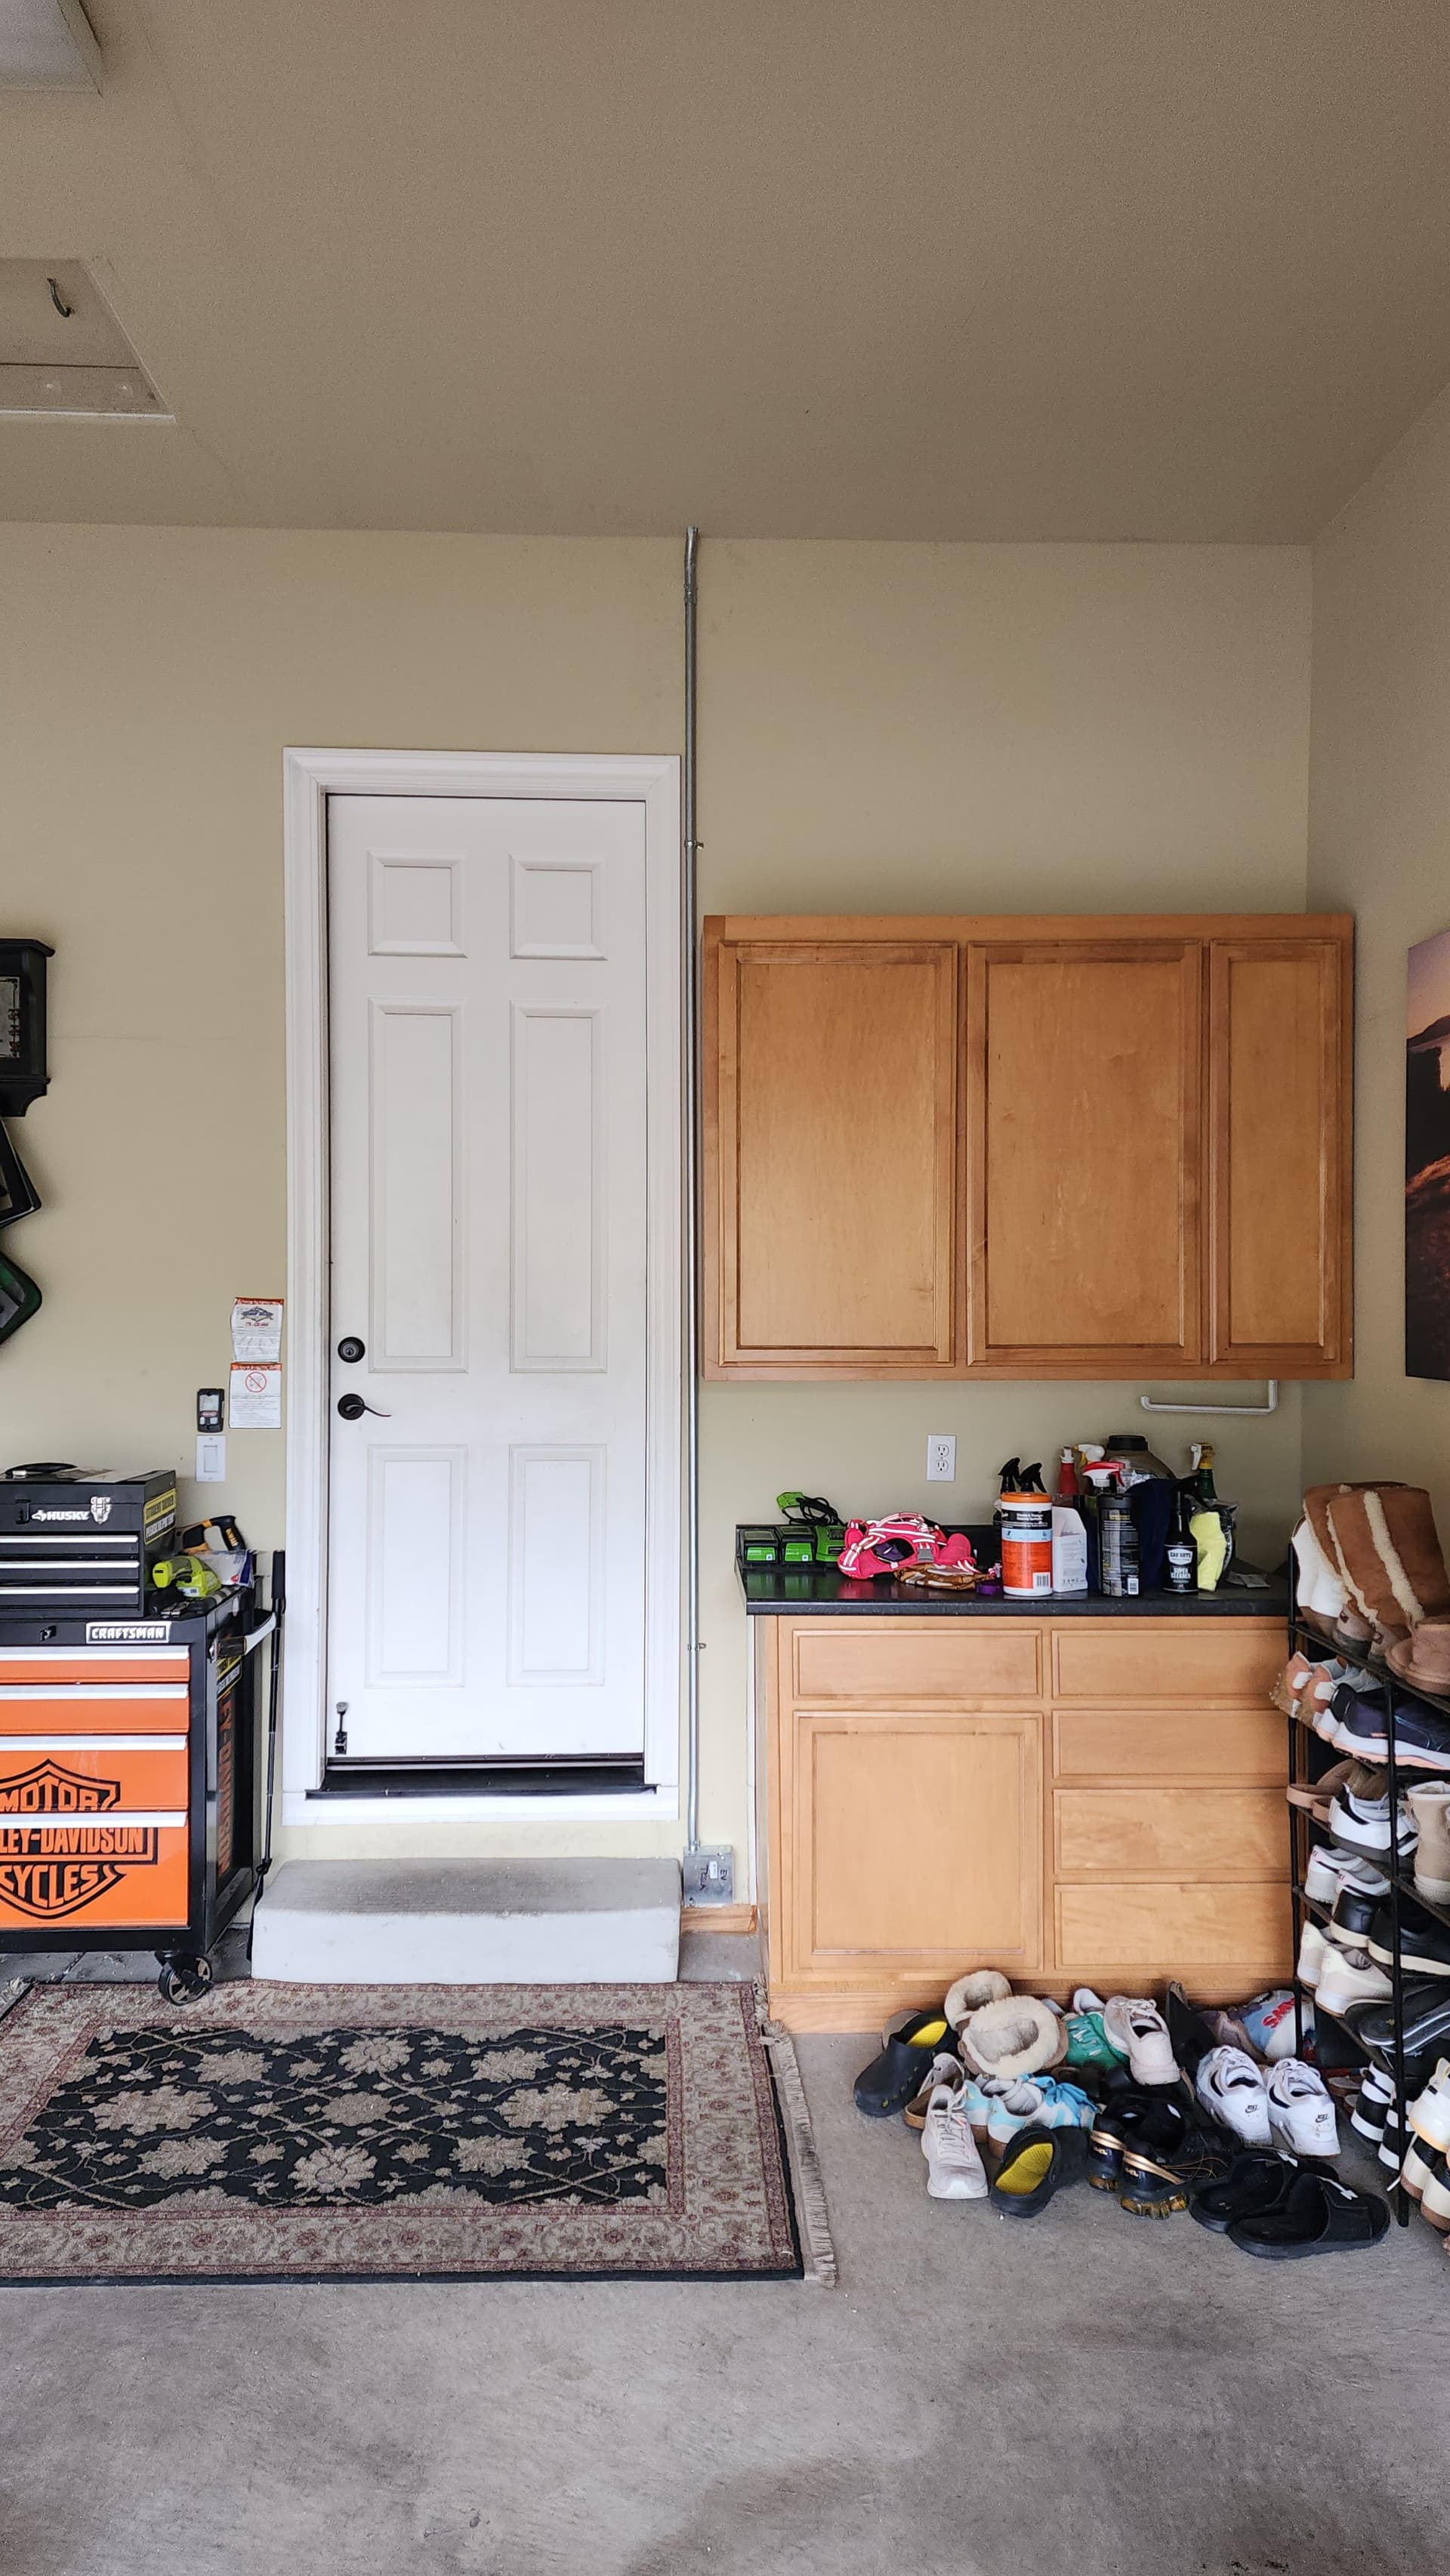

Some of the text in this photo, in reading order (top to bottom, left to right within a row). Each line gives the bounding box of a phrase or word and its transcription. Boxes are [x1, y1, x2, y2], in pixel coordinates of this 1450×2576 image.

[47, 1511, 91, 1521] HUSKY
[91, 1626, 165, 1639] CRAFTSMAN
[0, 1775, 98, 1812] MOTOR
[720, 1869, 727, 1881] EV
[0, 1864, 99, 1908] CYCLES
